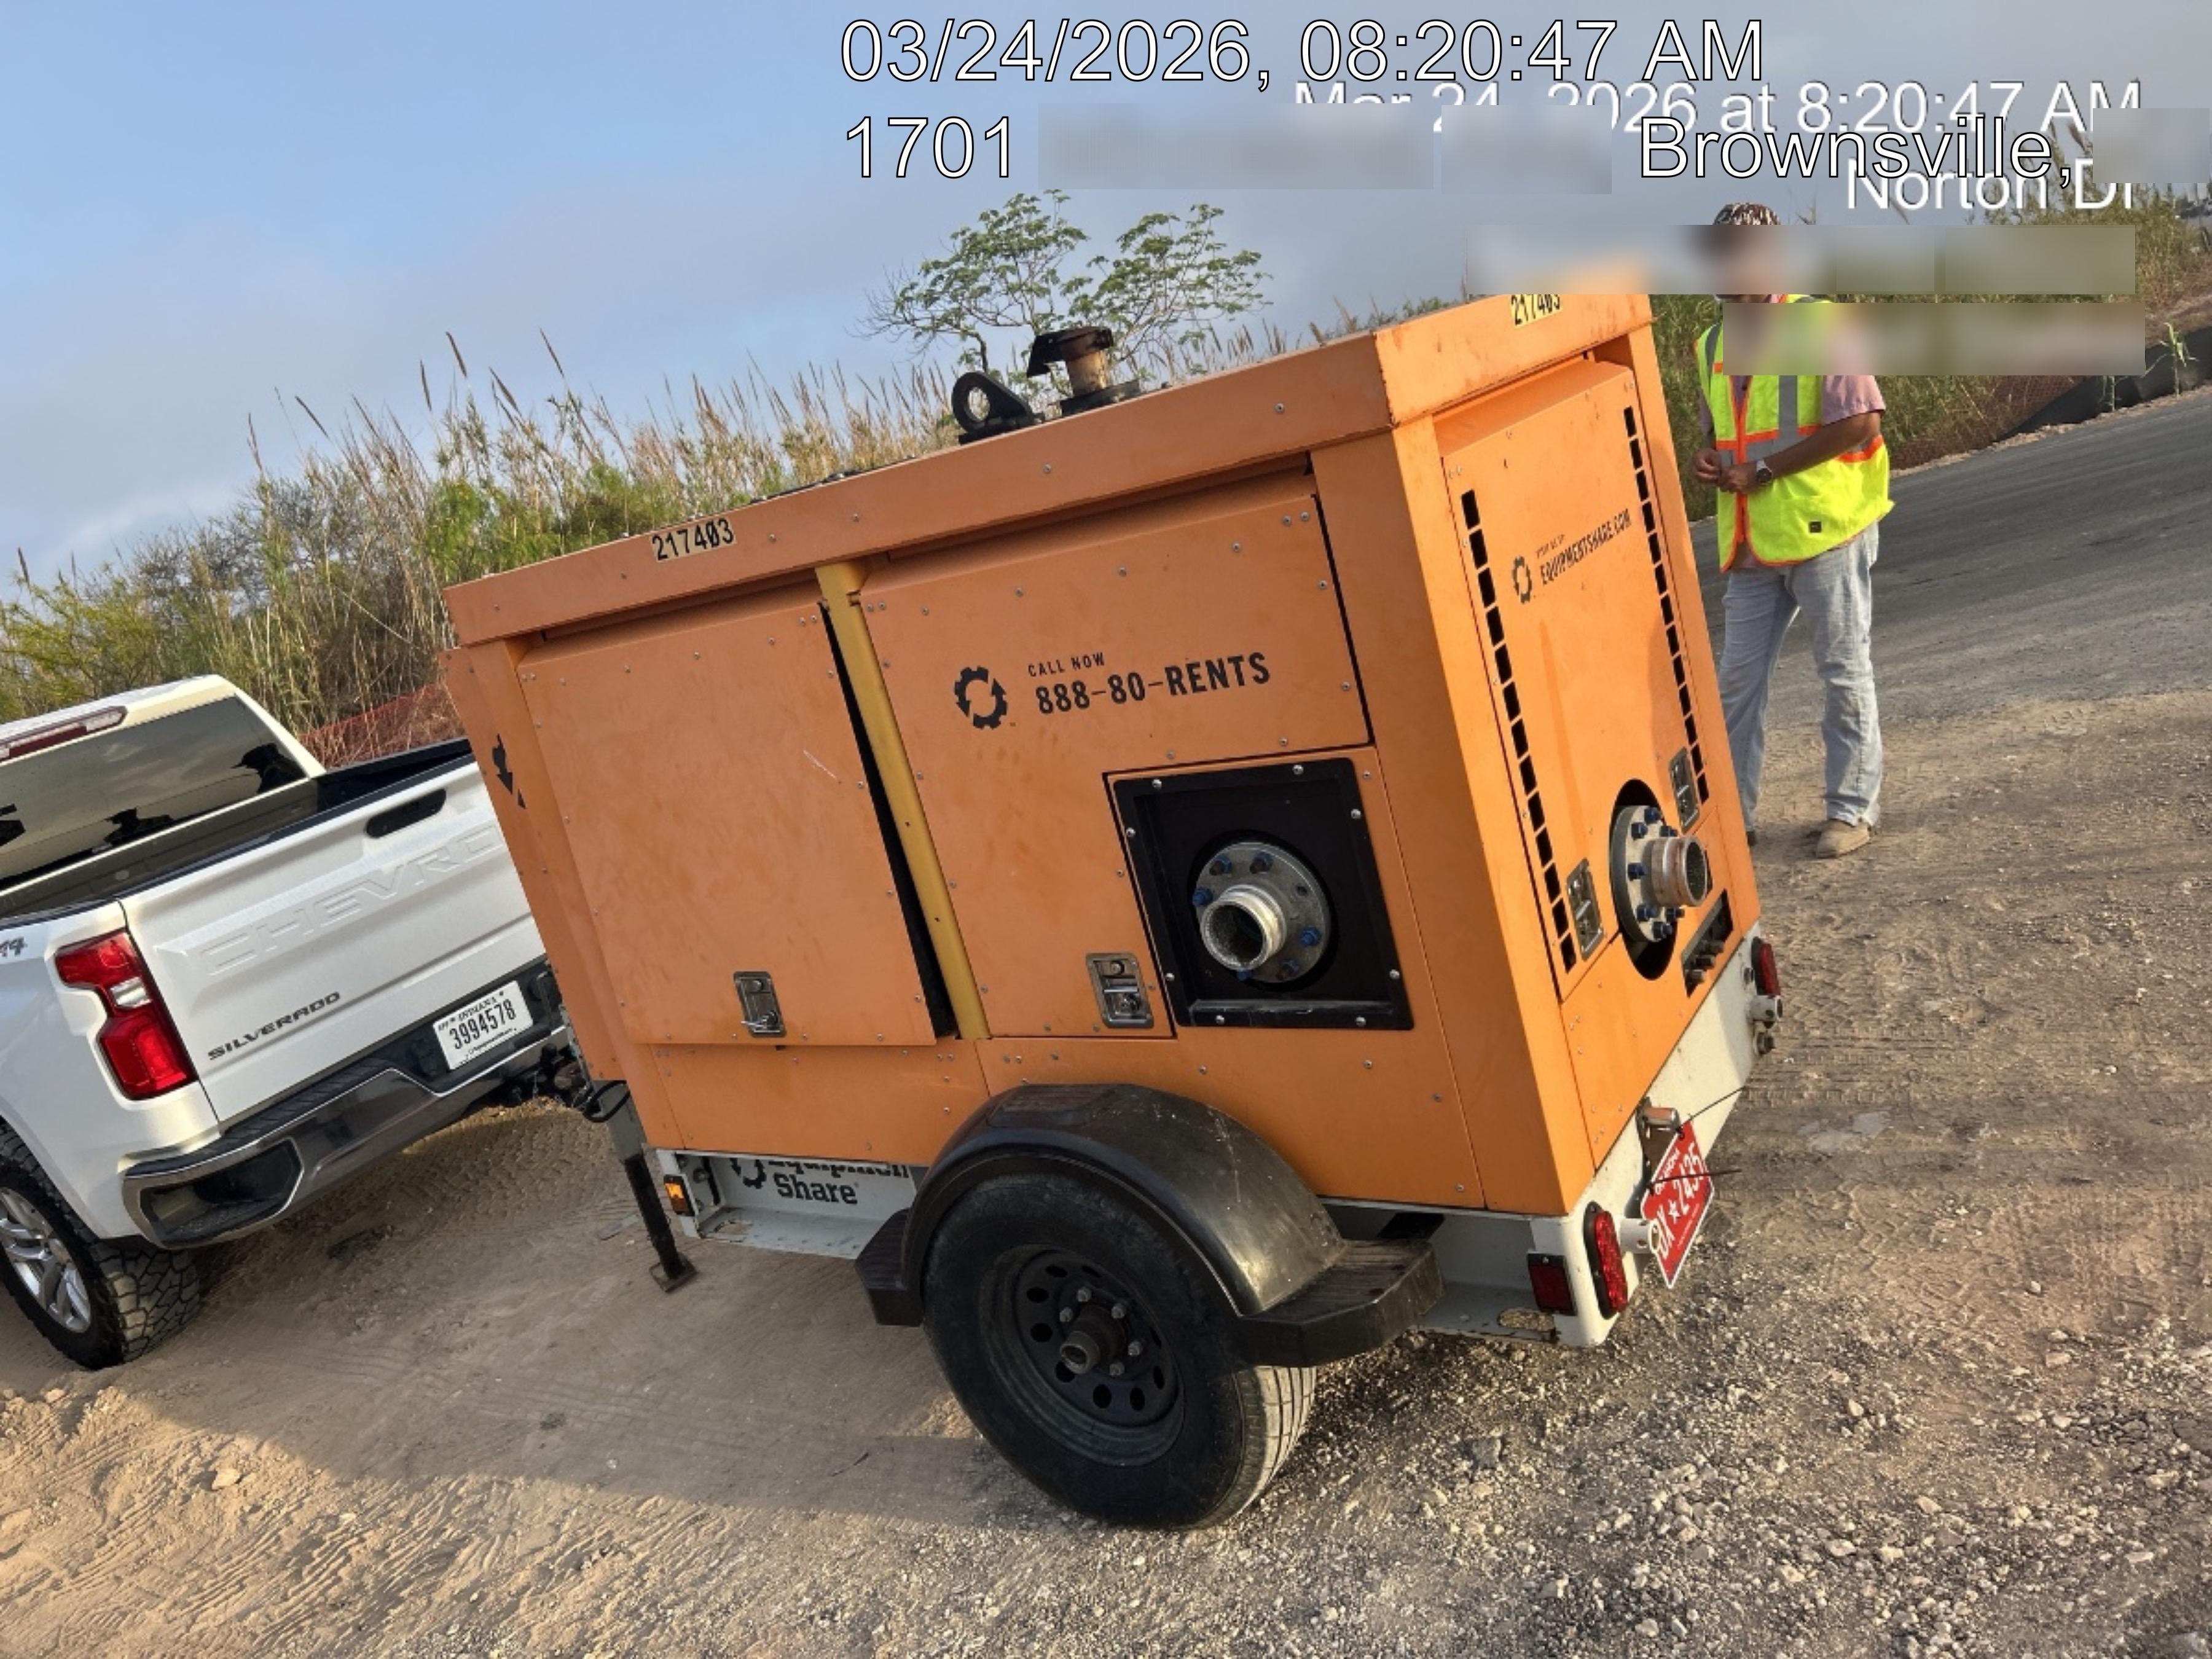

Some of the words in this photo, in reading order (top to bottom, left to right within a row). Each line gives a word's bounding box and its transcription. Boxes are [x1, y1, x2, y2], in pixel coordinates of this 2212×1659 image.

[1027, 659, 1065, 677] CALL
[1071, 652, 1105, 670] NOW
[1035, 651, 1271, 715] 888-80-RENTS
[208, 991, 341, 1061] SILVERADO
[449, 998, 517, 1049] 3994578
[773, 1172, 858, 1205] Share
